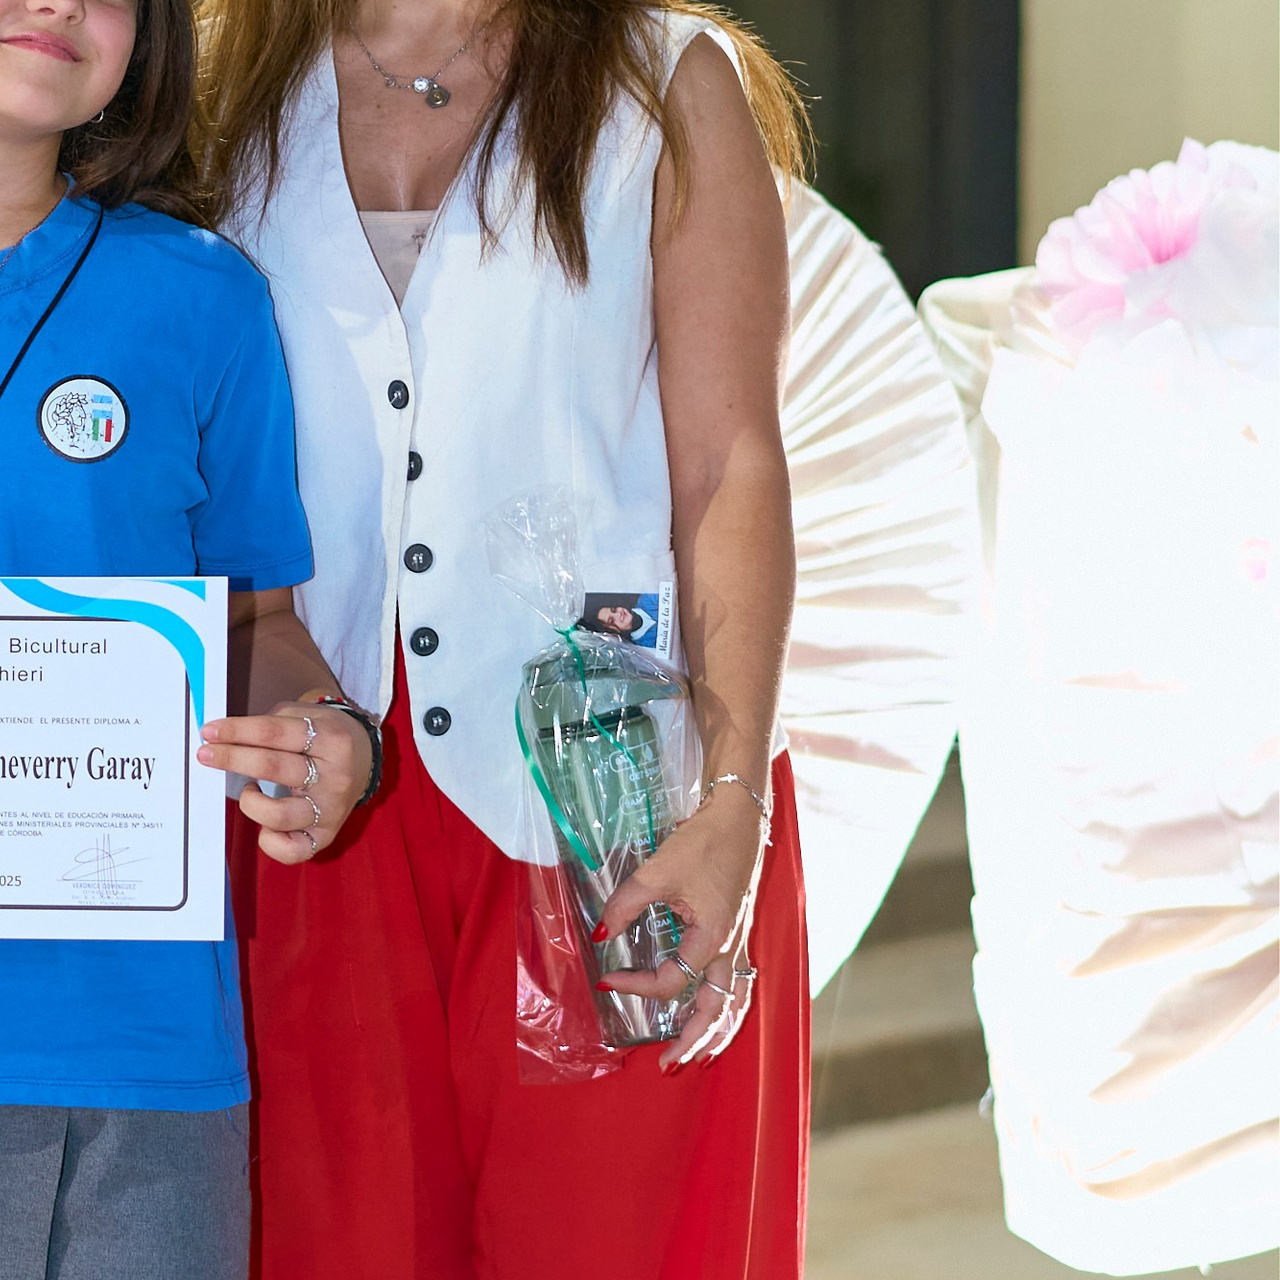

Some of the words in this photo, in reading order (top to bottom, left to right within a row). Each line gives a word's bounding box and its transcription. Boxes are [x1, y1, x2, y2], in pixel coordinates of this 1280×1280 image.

[661, 608, 670, 616] la
[661, 620, 669, 629] de
[9, 637, 107, 654] Bicultural
[94, 717, 130, 725] DIPLOMA
[87, 746, 155, 789] Garay
[68, 811, 108, 819] EDUCACIÓN
